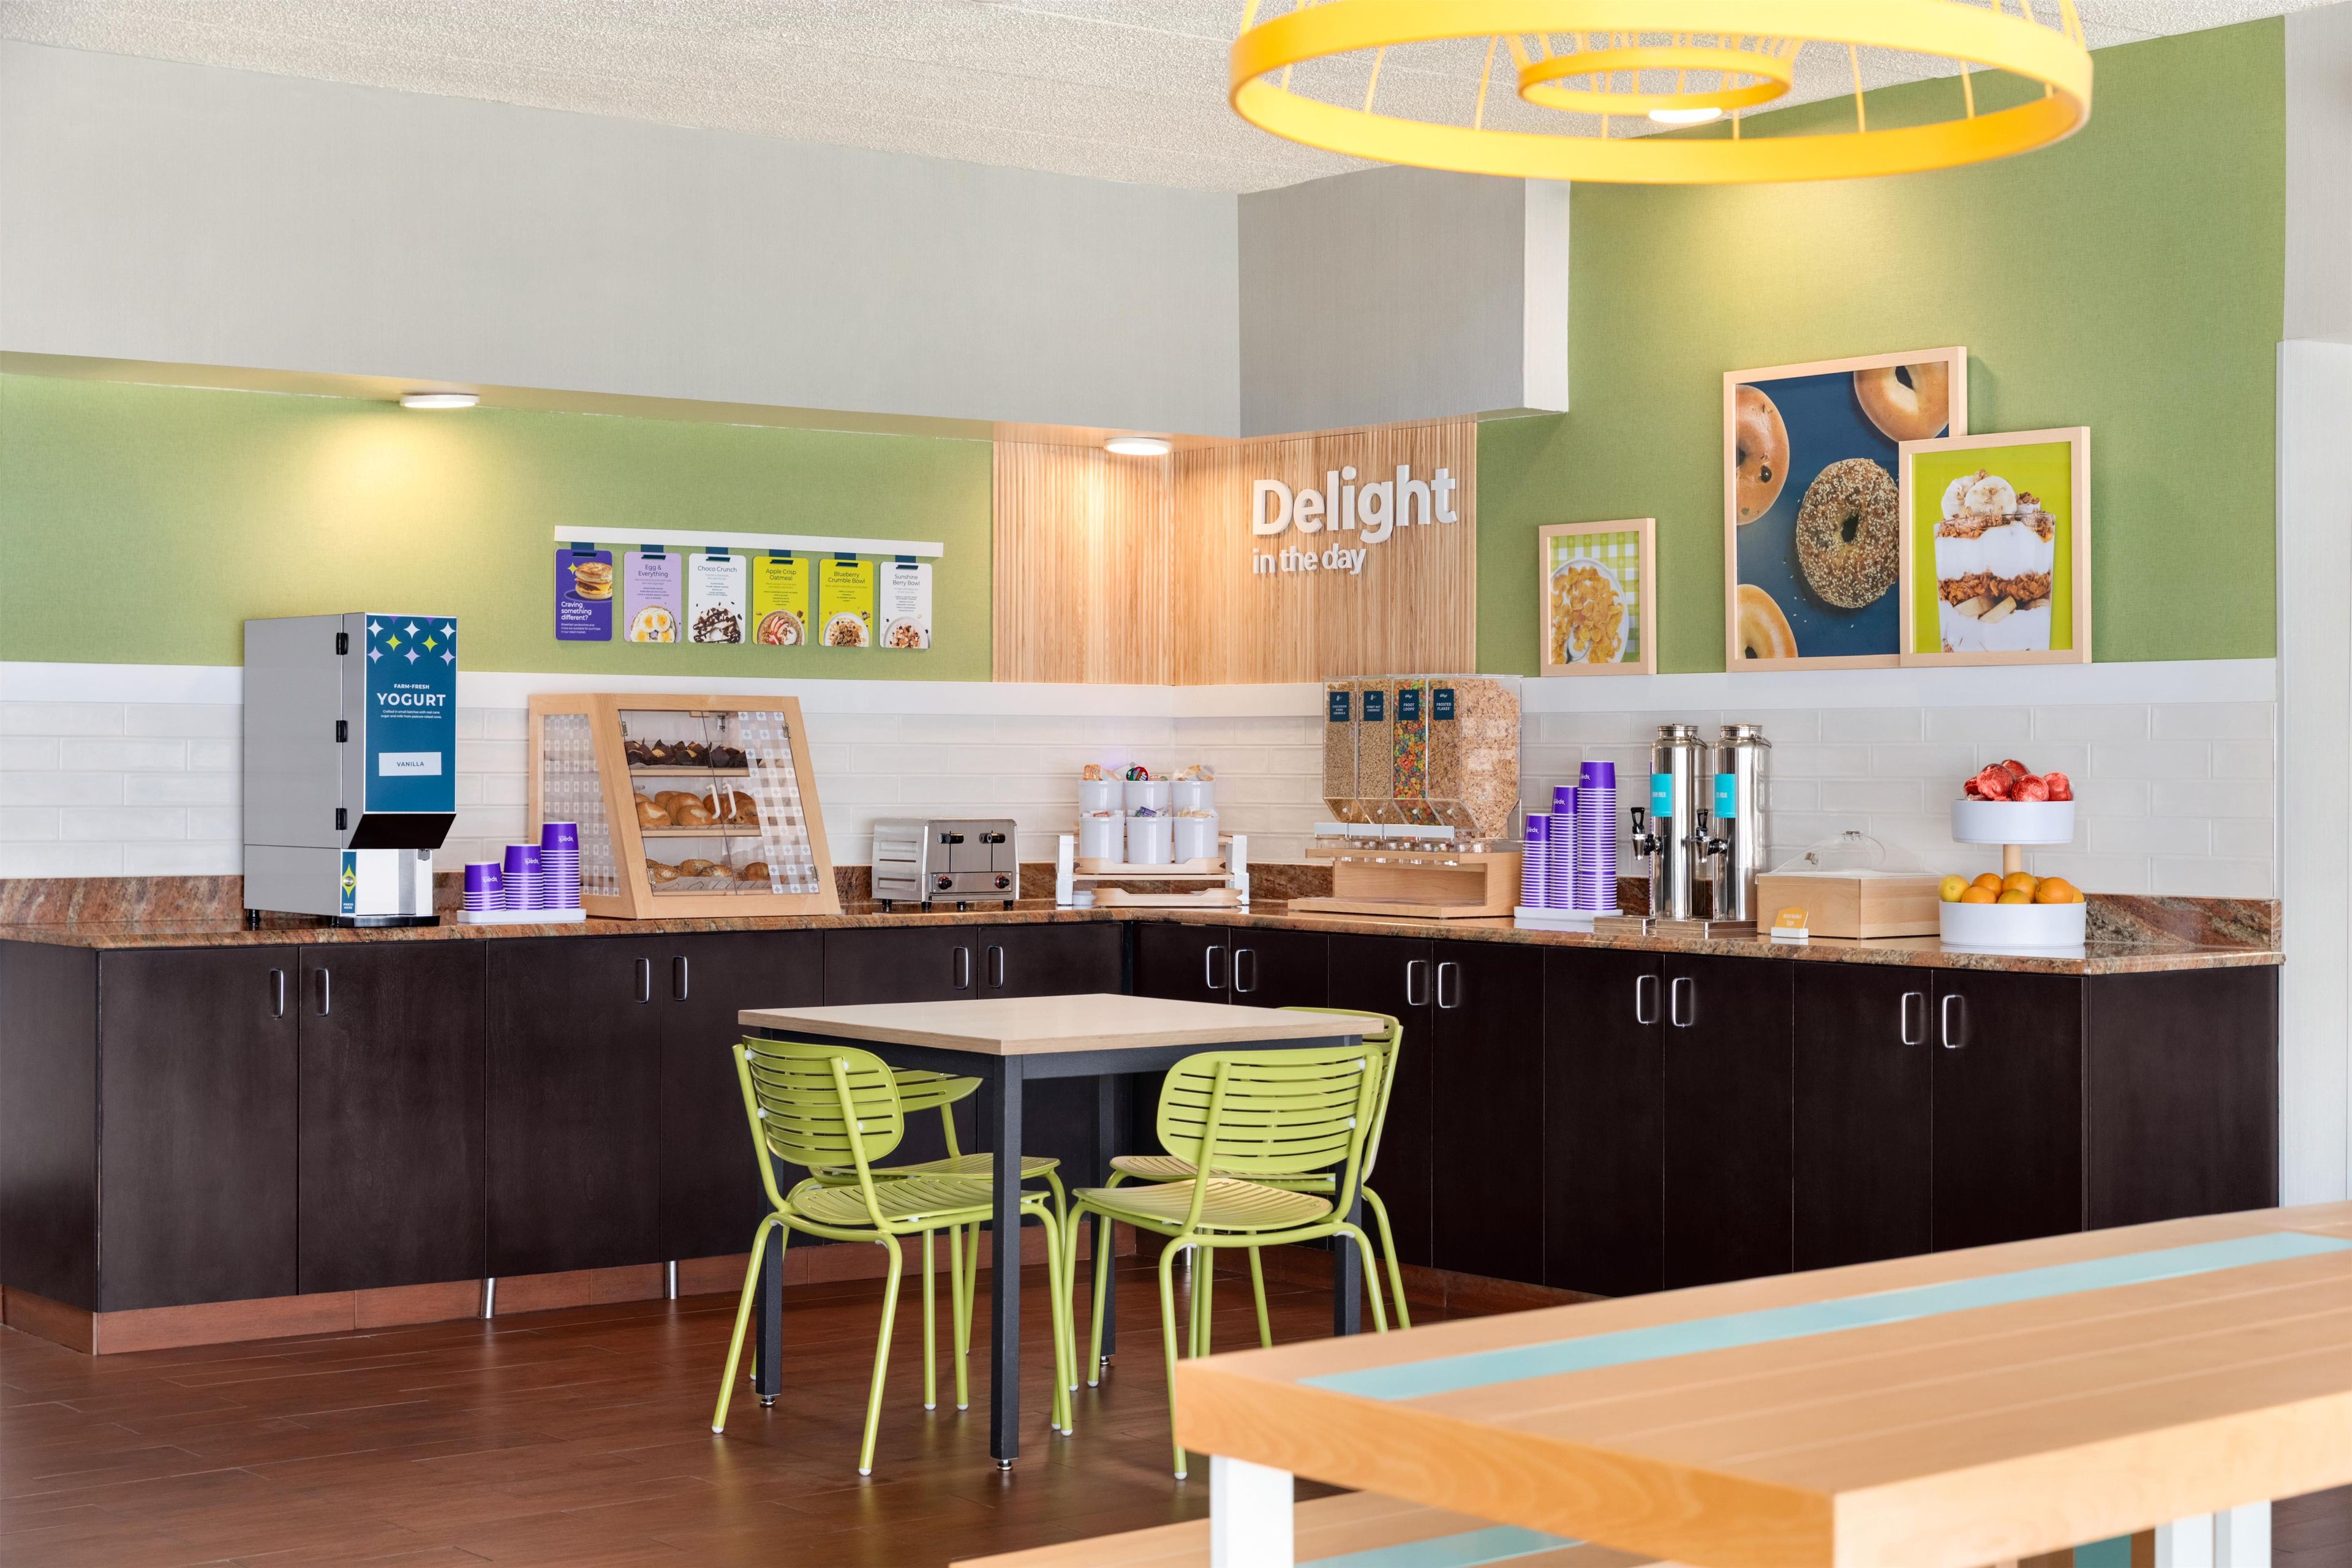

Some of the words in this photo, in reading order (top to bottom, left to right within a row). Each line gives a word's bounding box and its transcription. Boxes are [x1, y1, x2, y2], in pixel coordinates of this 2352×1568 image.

[1253, 464, 1458, 544] Delight
[1253, 548, 1276, 573] in
[1280, 545, 1318, 572] the
[1322, 543, 1366, 575] day
[377, 693, 446, 706] YOGURT
